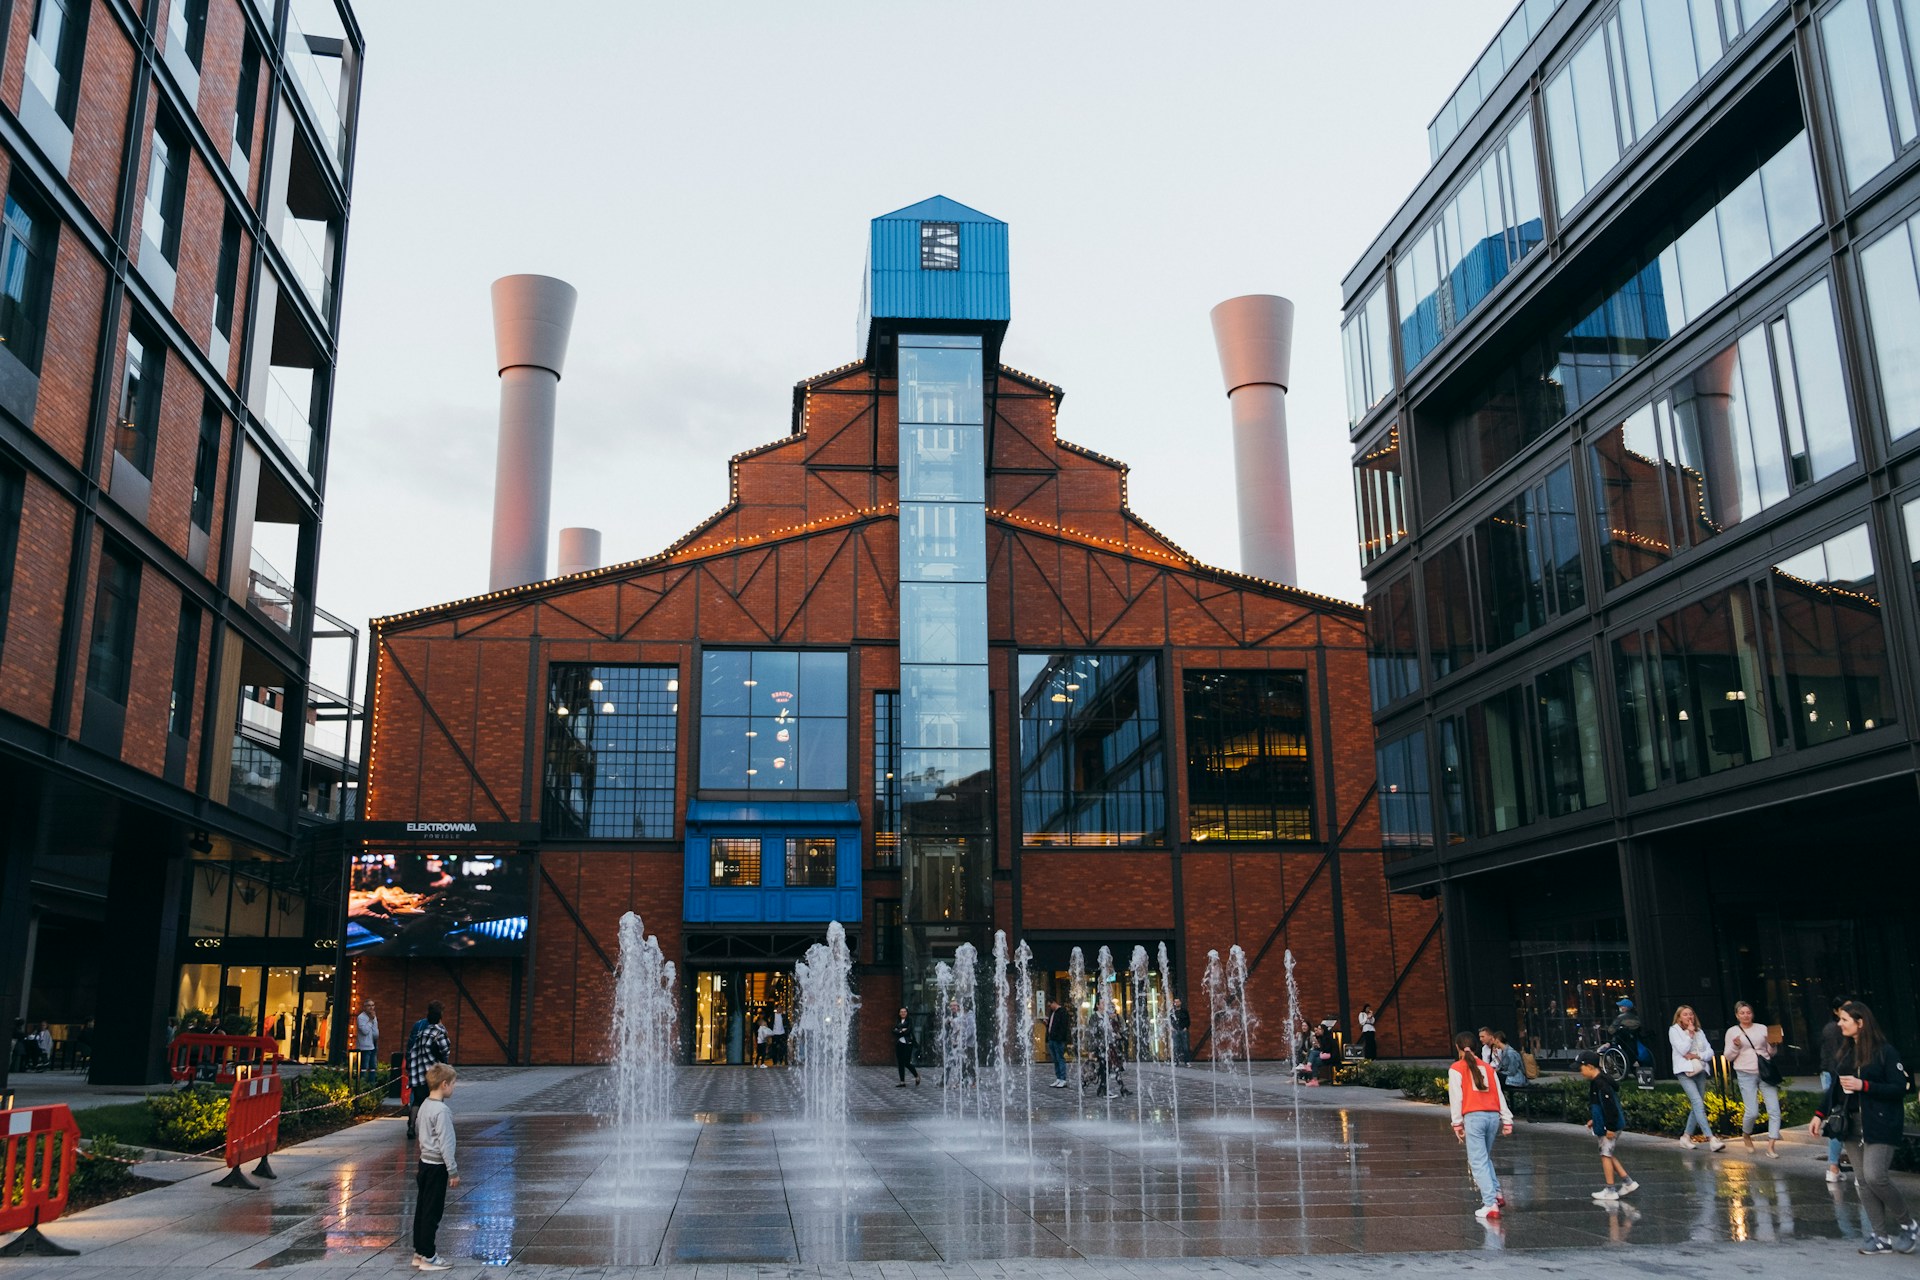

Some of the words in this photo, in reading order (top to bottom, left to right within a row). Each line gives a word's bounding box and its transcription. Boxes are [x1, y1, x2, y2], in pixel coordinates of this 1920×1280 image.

[406, 823, 477, 832] ELEKTROWNIA
[194, 938, 221, 948] COS
[314, 939, 339, 949] COS
